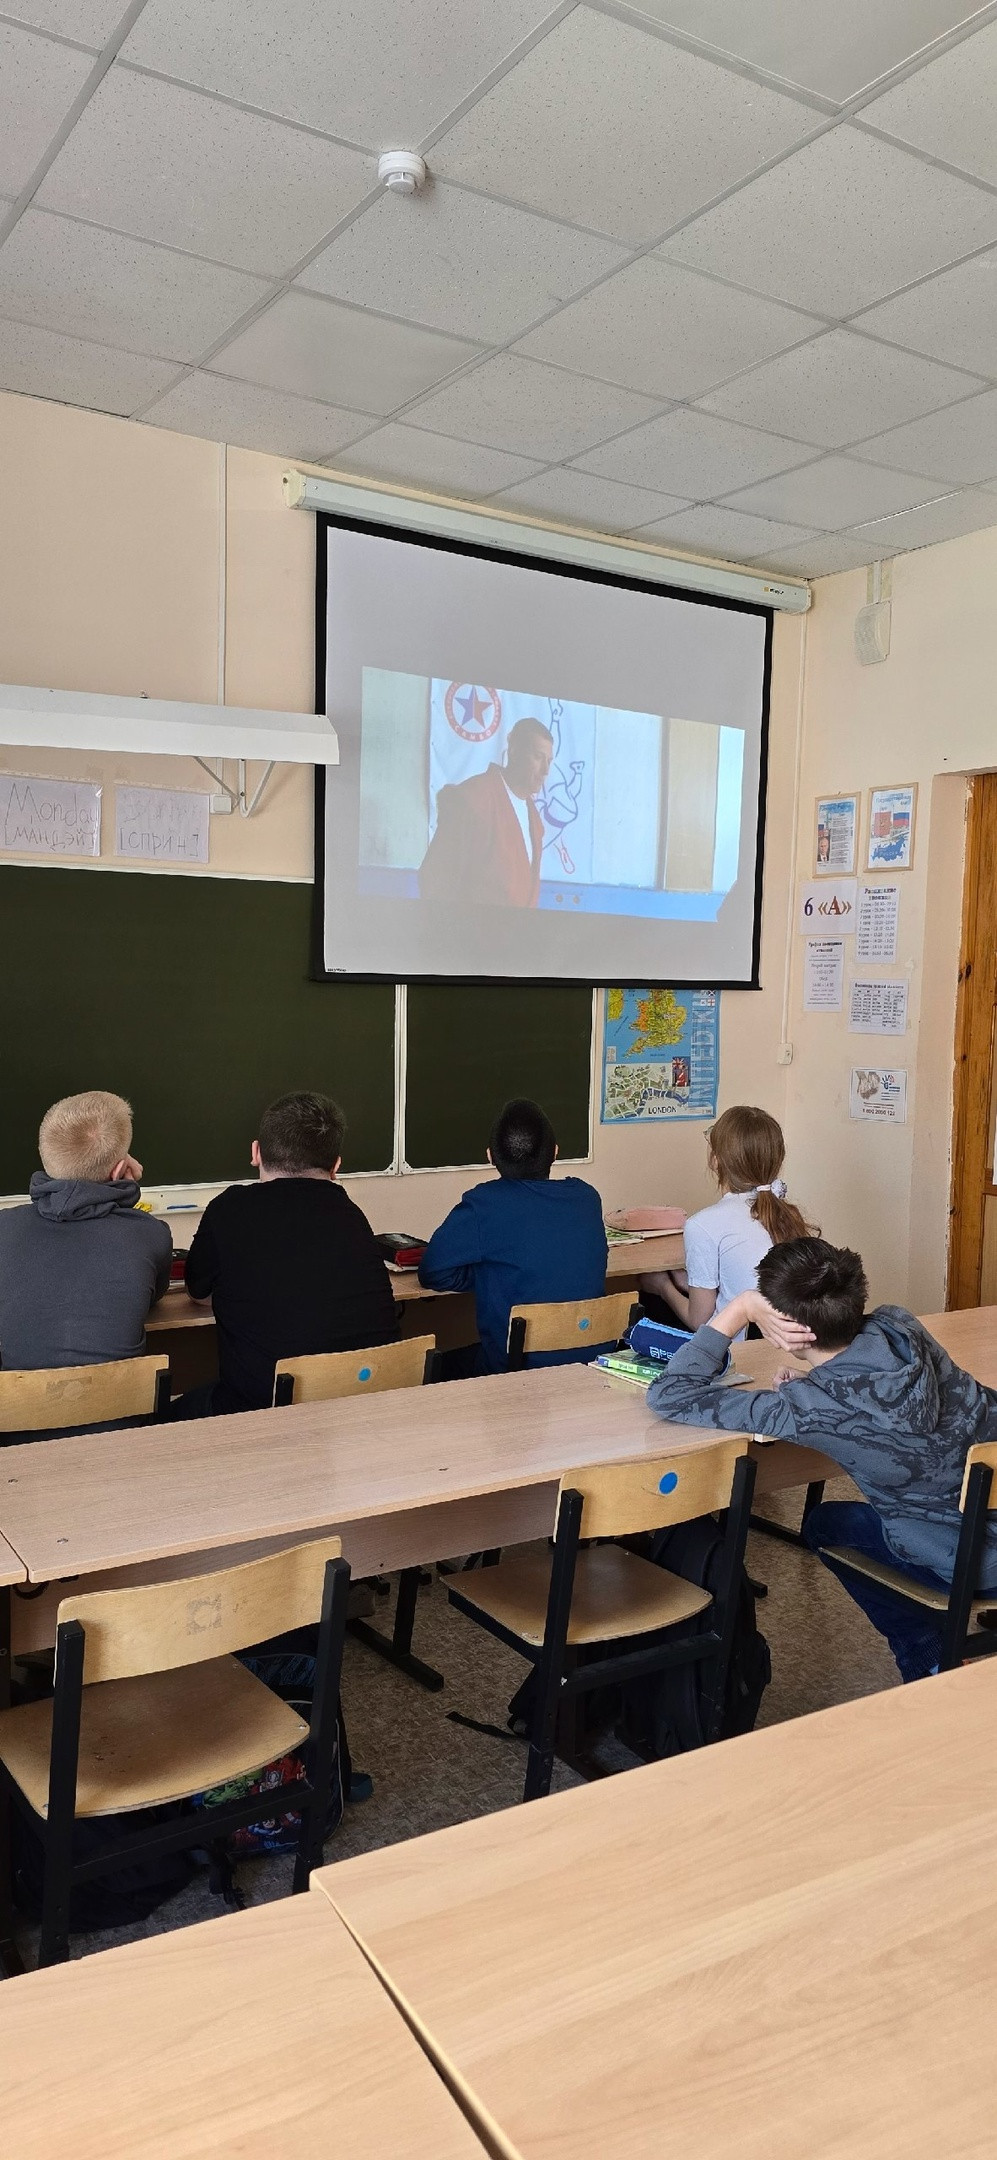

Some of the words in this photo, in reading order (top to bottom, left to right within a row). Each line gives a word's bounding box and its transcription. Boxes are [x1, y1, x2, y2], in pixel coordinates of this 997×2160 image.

[804, 896, 815, 917] 6
[818, 895, 853, 916] «А»
[648, 1106, 677, 1114] LONDON
